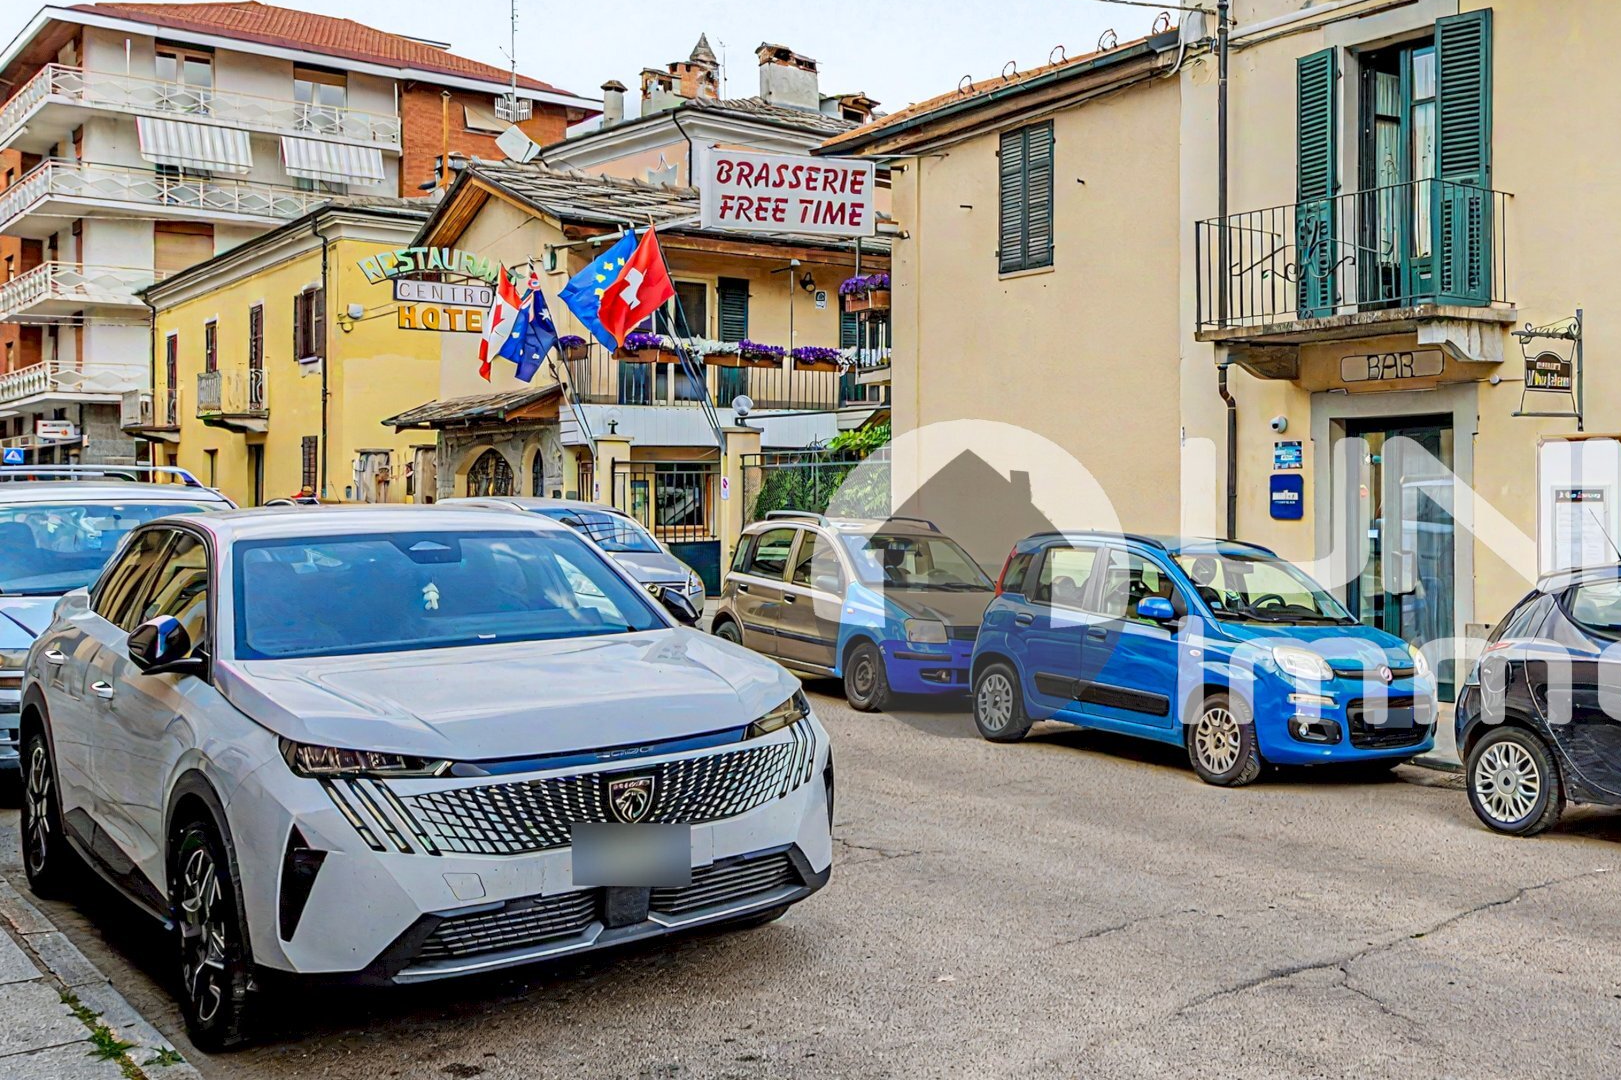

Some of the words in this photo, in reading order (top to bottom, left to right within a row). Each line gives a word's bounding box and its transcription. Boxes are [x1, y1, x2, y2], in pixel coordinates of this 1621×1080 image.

[716, 159, 867, 195] BRASSERIE
[719, 194, 789, 222] FREE
[799, 198, 865, 226] TIME
[399, 282, 493, 304] CENTRO
[398, 305, 490, 332] HOTE
[1366, 351, 1415, 380] BAR
